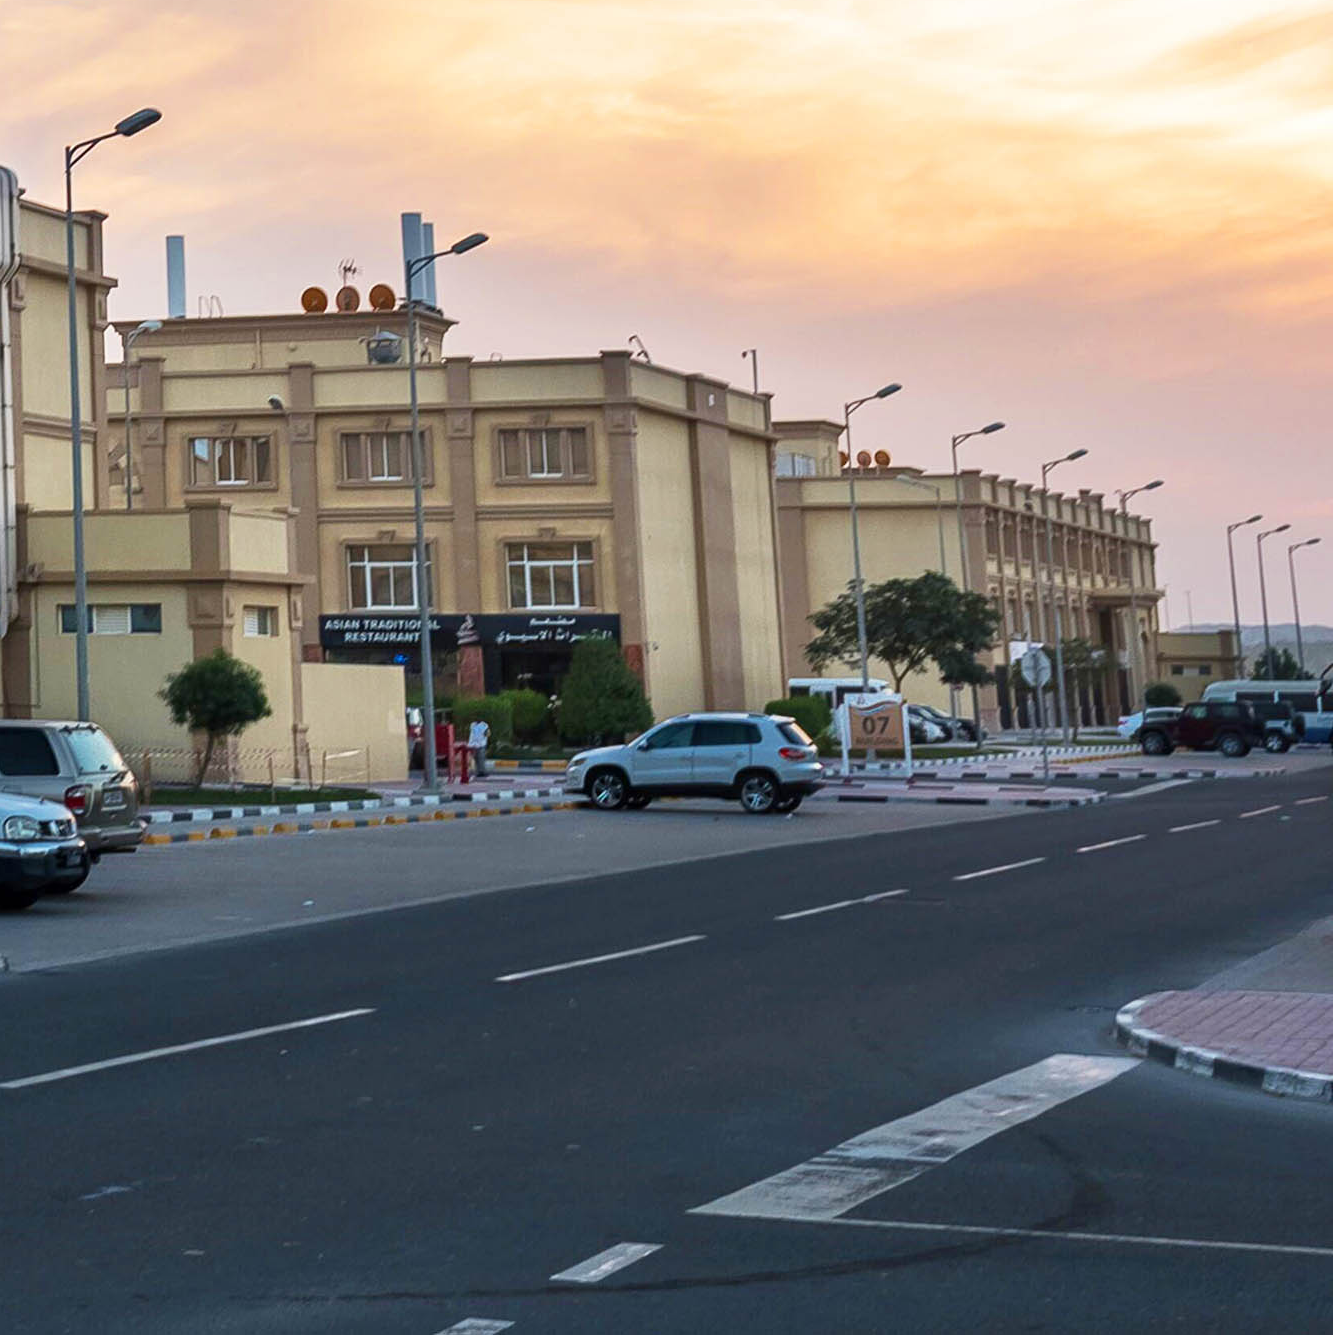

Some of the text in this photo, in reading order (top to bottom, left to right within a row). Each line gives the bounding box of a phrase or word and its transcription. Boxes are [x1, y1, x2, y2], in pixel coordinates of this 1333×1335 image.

[324, 619, 442, 630] ASIAN TRADITIOAL
[344, 631, 421, 642] RESTAURANT
[862, 716, 890, 735] 07
